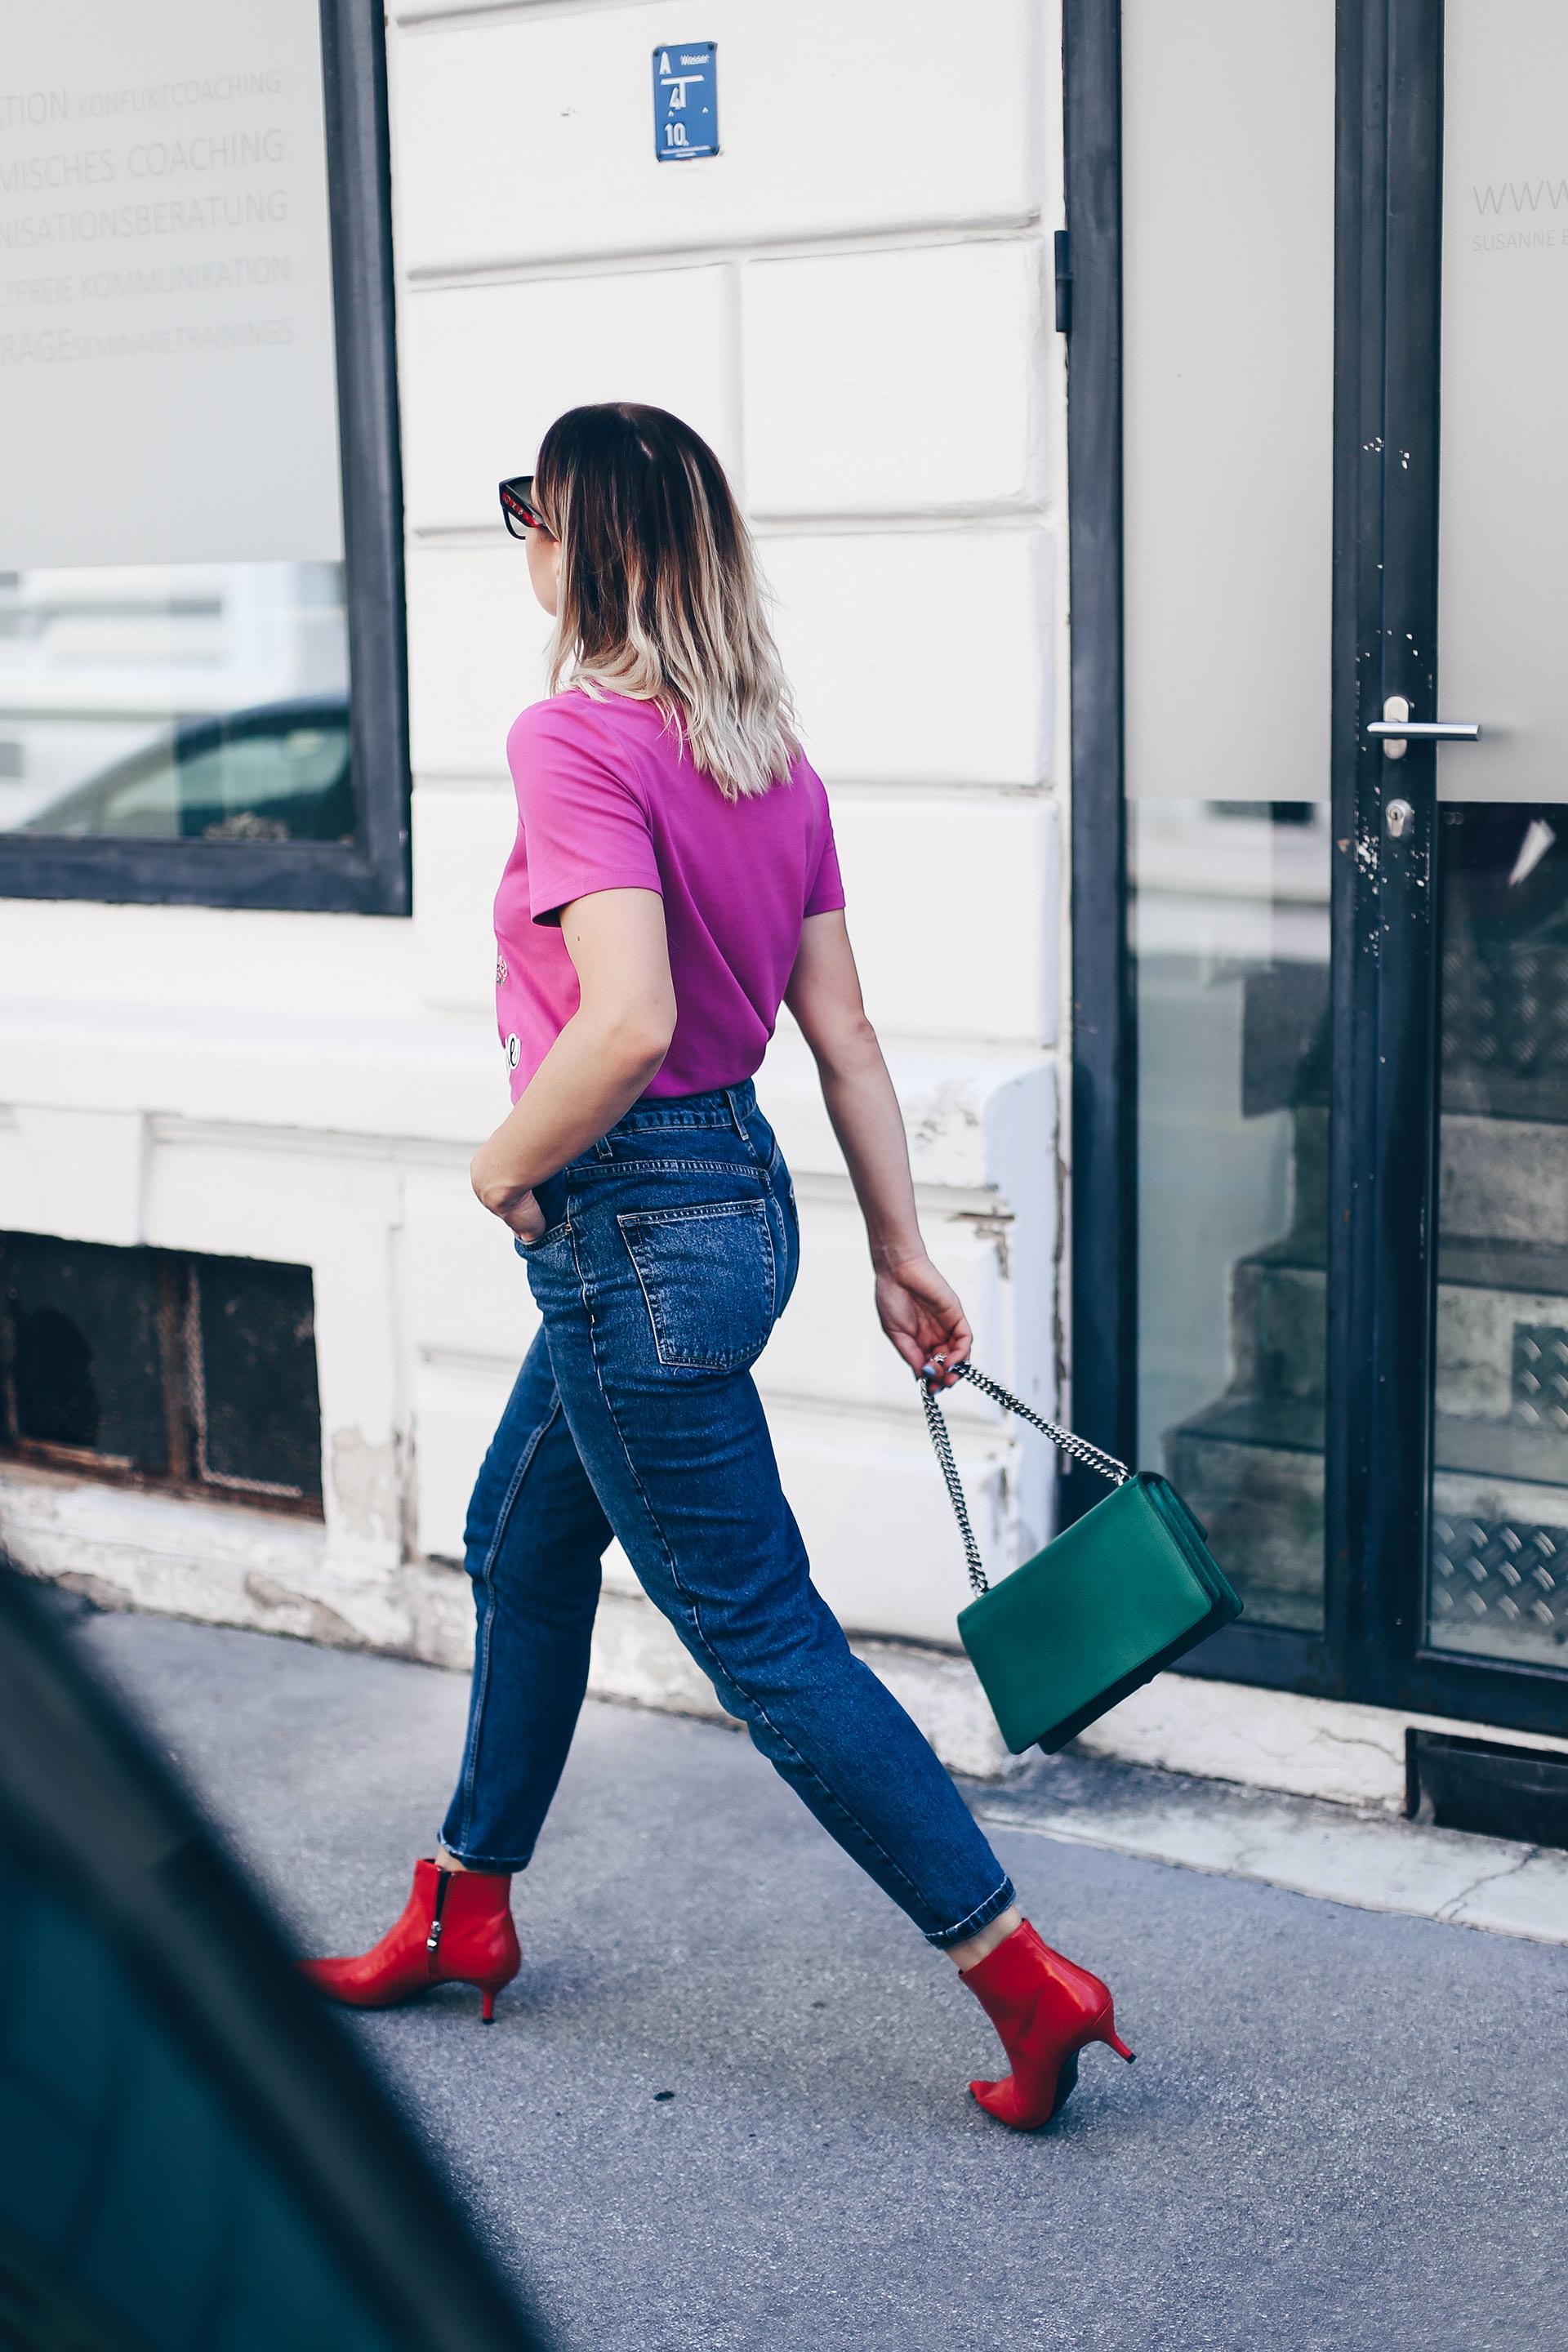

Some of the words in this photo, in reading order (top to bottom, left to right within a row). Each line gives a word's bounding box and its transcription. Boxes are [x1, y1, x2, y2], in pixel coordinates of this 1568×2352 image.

[659, 51, 671, 75] A
[0, 89, 69, 129] TION
[78, 69, 282, 118] KONFLIKTCOACHING
[127, 127, 284, 178] COACHING
[1472, 229, 1556, 252] SUSANNE
[0, 274, 77, 309] TFREIE
[80, 255, 291, 301] KOMMUNIKATION
